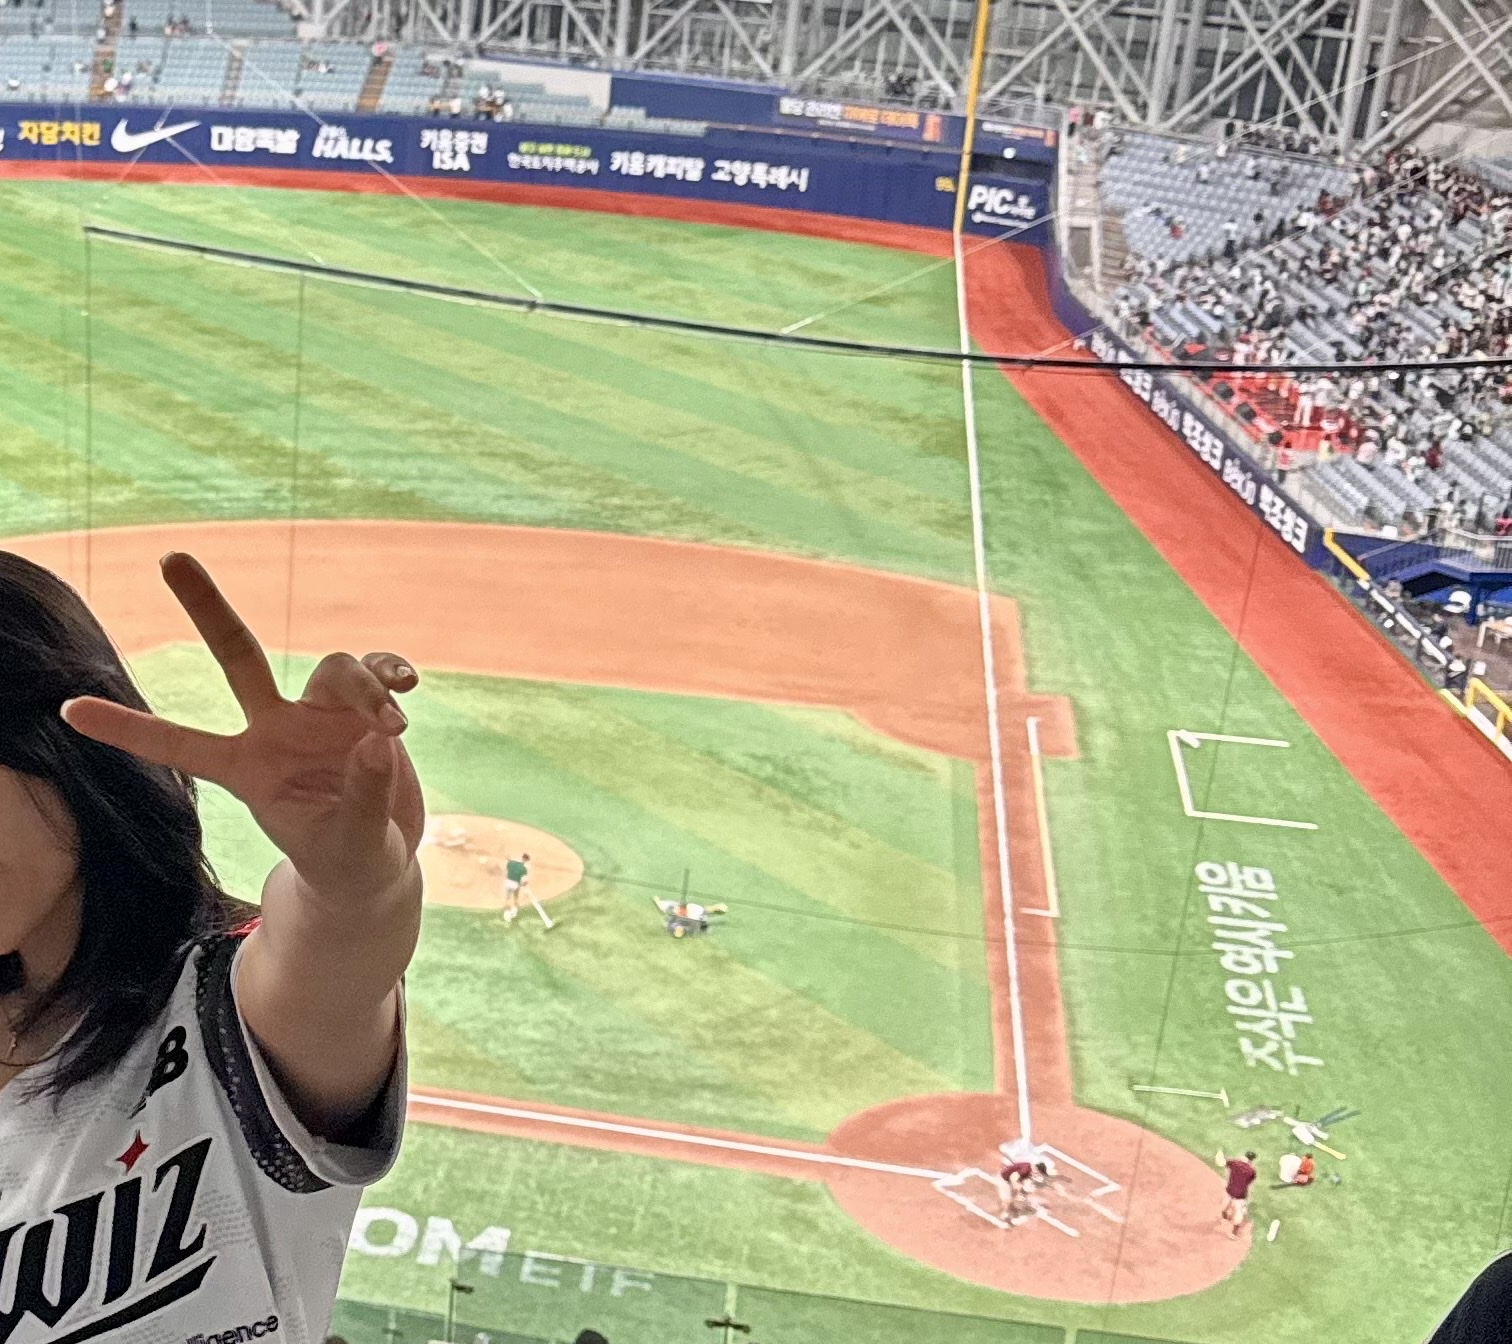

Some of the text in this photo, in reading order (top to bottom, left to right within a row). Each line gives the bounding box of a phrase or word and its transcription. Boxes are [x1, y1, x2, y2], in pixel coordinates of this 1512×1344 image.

[419, 128, 489, 155] 키움증권
[431, 151, 472, 171] ISA
[609, 150, 707, 182] 키움캐피탈
[710, 158, 811, 193] 고양특례시
[1193, 860, 1325, 1077] 주식은 역시 키움
